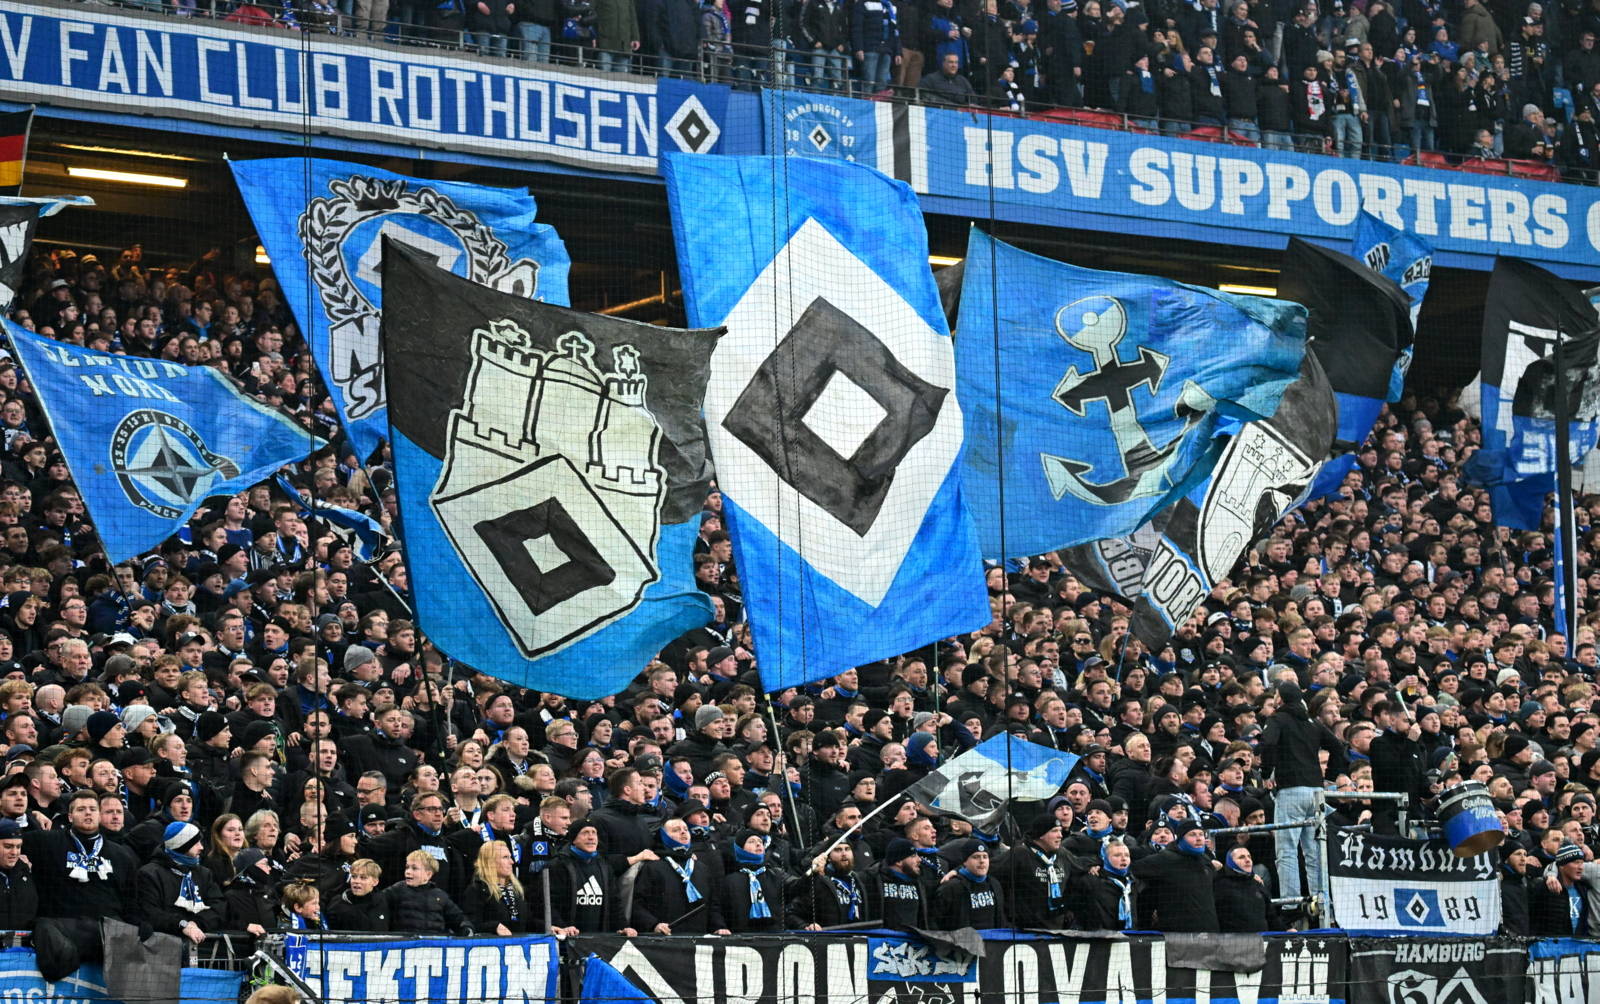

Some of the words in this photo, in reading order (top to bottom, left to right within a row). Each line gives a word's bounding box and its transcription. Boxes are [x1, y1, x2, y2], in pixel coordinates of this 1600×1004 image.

[60, 22, 173, 97] FAN
[197, 37, 349, 119] CLUB
[370, 59, 657, 157] ROTHOSEN
[786, 103, 841, 122] HAMBURGER
[786, 129, 800, 142] 18
[842, 135, 855, 148] 87
[964, 126, 1109, 199] HSV
[1129, 148, 1570, 250] SUPPORTERS
[1358, 893, 1388, 921] 19
[1444, 895, 1481, 921] 89
[1395, 942, 1486, 963] HAMBURG
